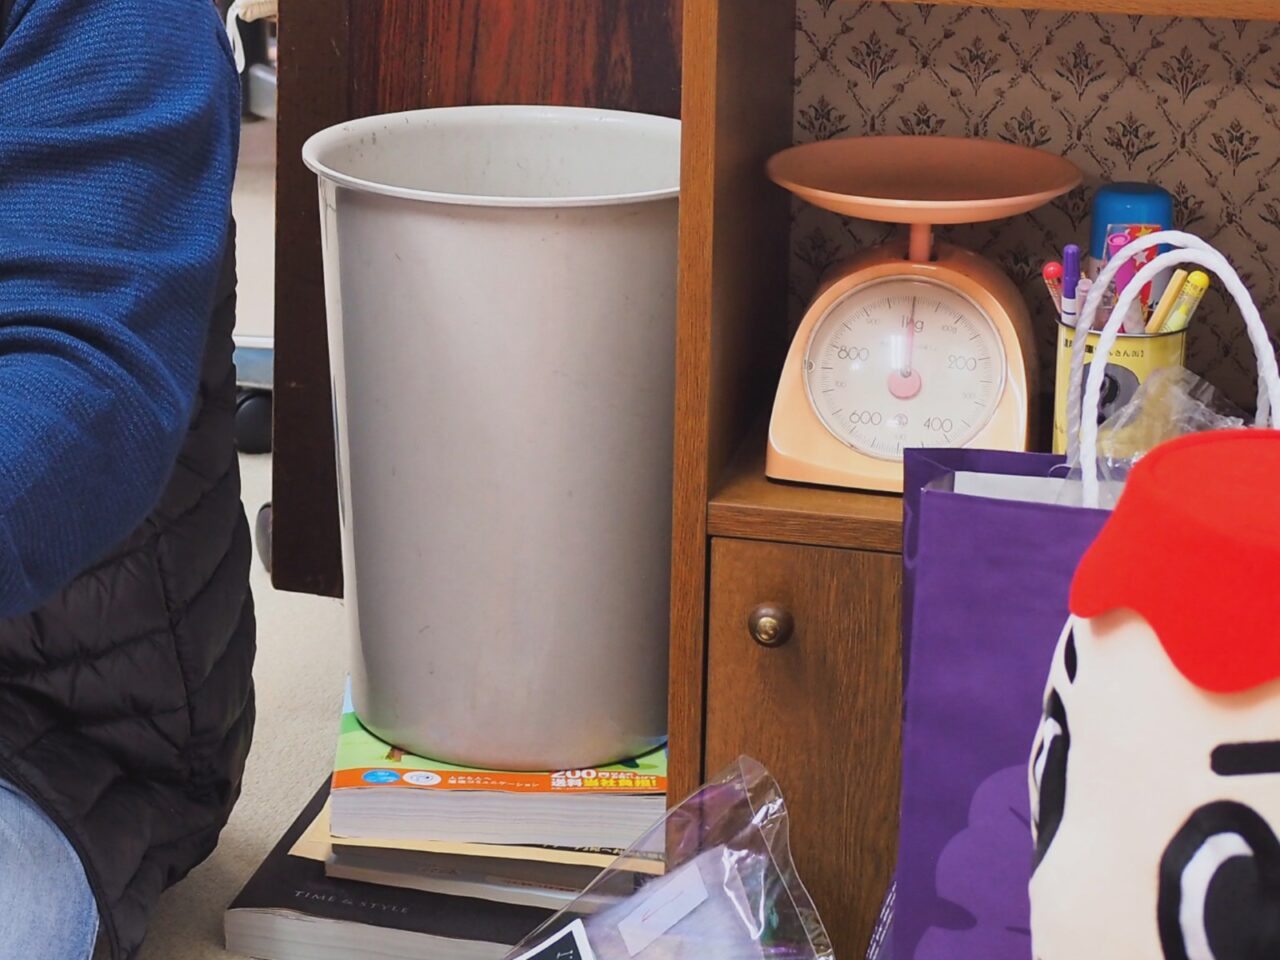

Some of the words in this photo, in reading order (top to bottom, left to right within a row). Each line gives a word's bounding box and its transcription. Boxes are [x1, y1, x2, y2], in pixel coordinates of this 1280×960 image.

[837, 346, 869, 362] 800
[948, 354, 977, 371] 200
[849, 411, 882, 426] 600
[923, 417, 953, 433] 400
[295, 890, 335, 902] TIME
[361, 901, 409, 913] STYLE
